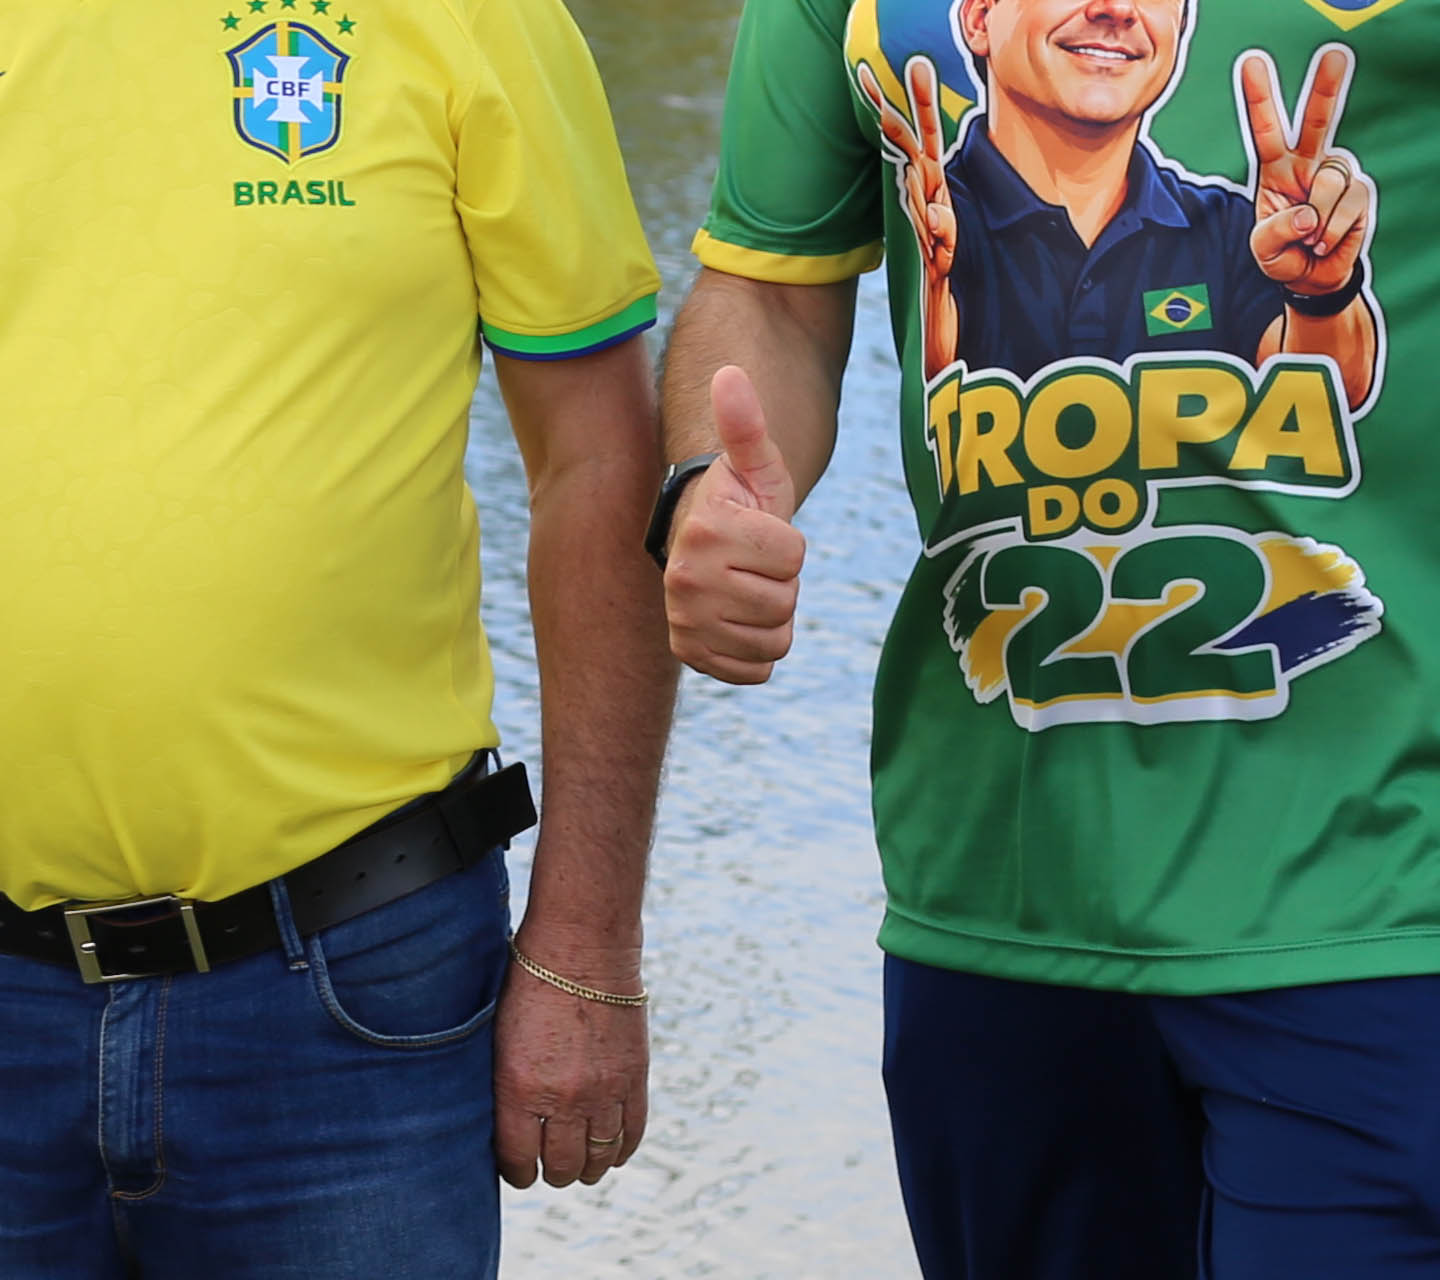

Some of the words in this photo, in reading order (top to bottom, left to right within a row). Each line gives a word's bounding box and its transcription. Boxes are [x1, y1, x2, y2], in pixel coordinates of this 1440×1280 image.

[266, 80, 311, 98] CBF
[233, 180, 356, 207] BRASIL
[929, 365, 1345, 496] TROPA
[1028, 478, 1139, 536] DO
[984, 534, 1278, 708] 22
